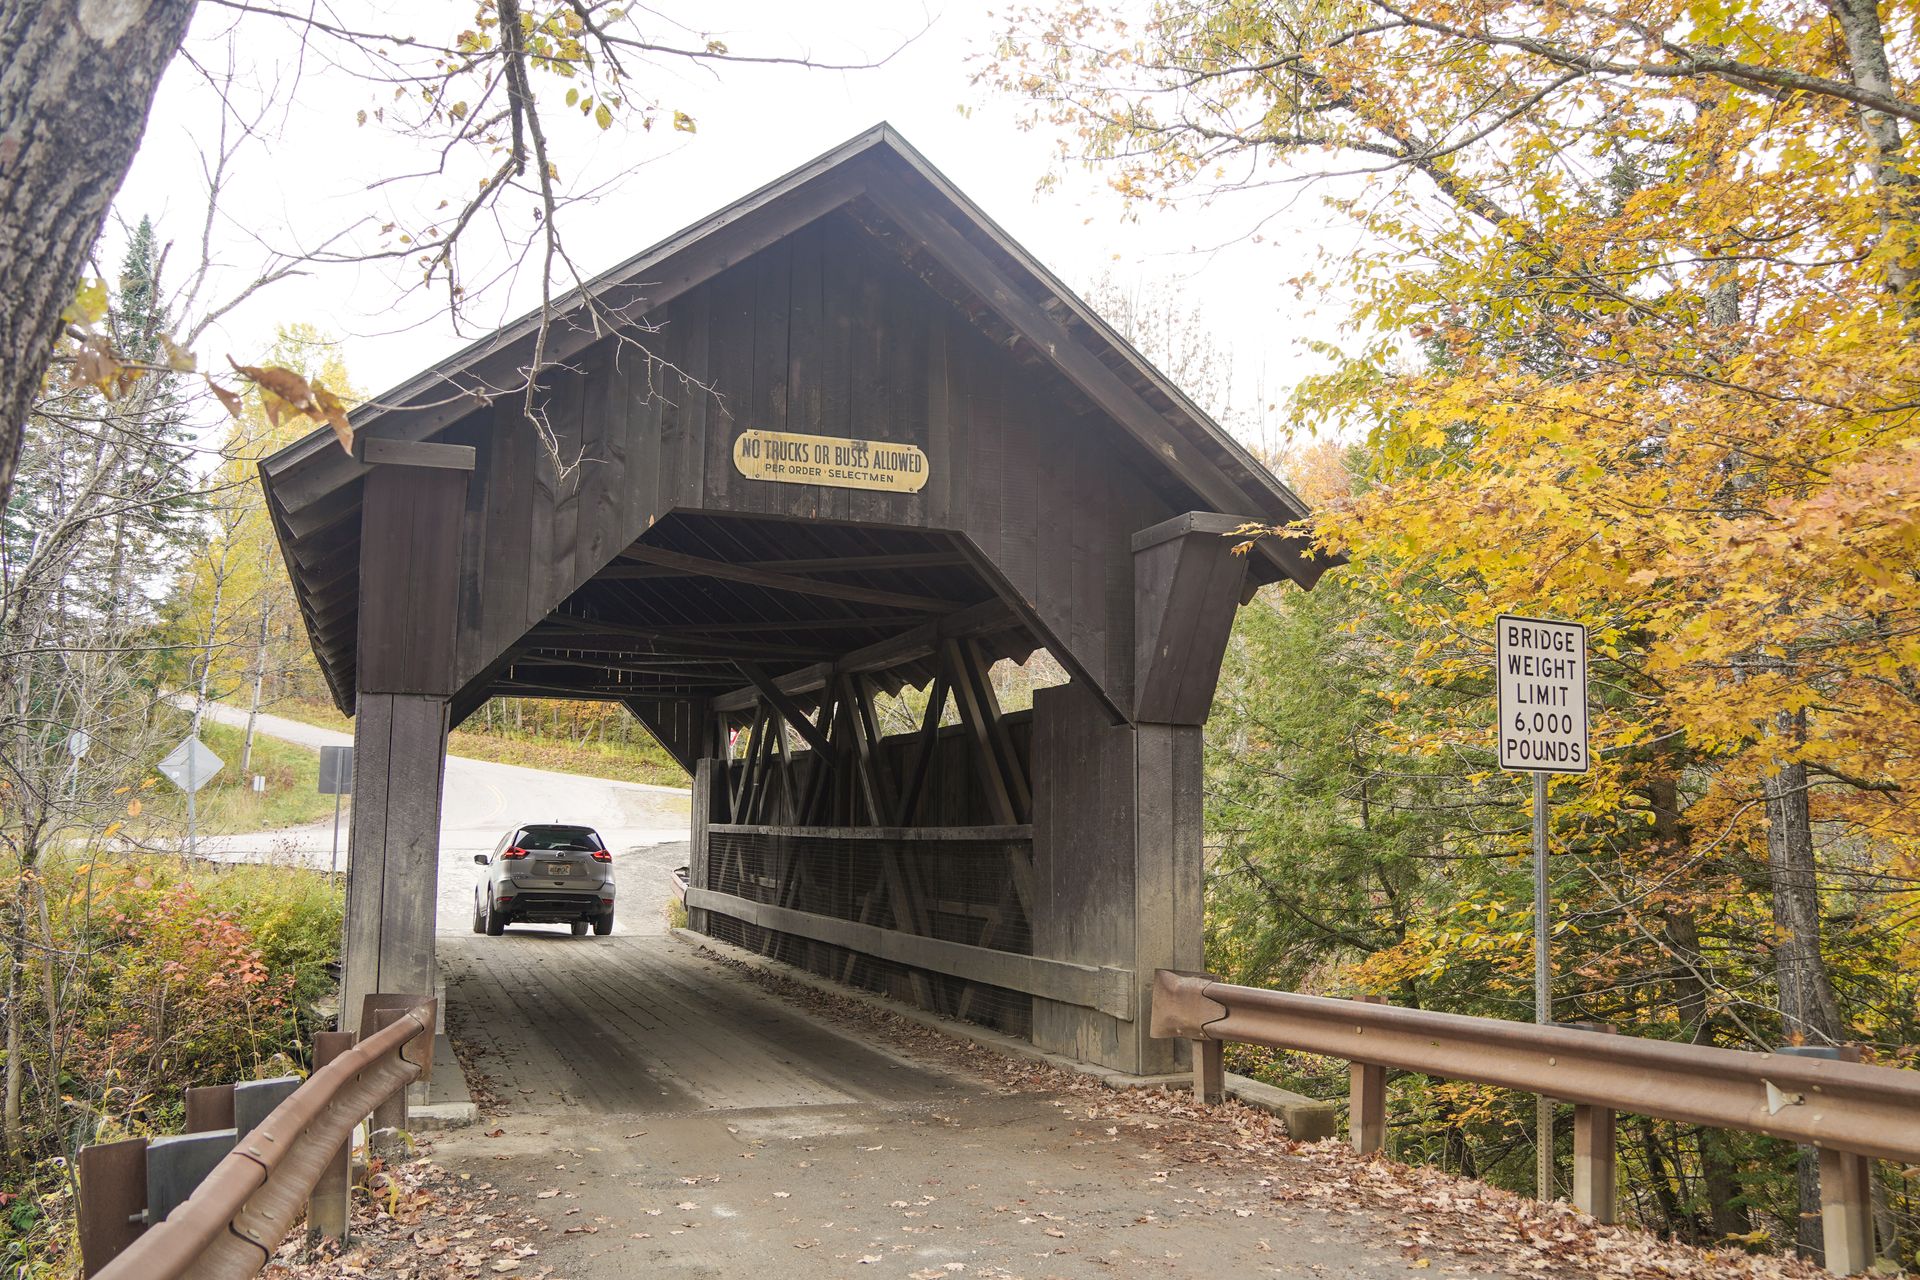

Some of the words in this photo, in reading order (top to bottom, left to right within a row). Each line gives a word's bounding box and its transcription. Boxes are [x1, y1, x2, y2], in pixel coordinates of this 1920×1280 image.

[742, 437, 761, 458] NO
[764, 439, 809, 463] TRUCKS
[814, 444, 830, 465] OR
[835, 446, 869, 469] BUSES
[873, 450, 922, 473] ALLOWED
[765, 463, 785, 474] PER
[788, 465, 822, 477] ORDER
[828, 468, 893, 483] SELECTMEN
[1508, 626, 1575, 652] BRIDGE
[1508, 654, 1576, 680] WEIGHT
[1517, 683, 1568, 706] LIMIT
[1514, 711, 1572, 735] 6,000
[1507, 738, 1580, 762] POUNDS
